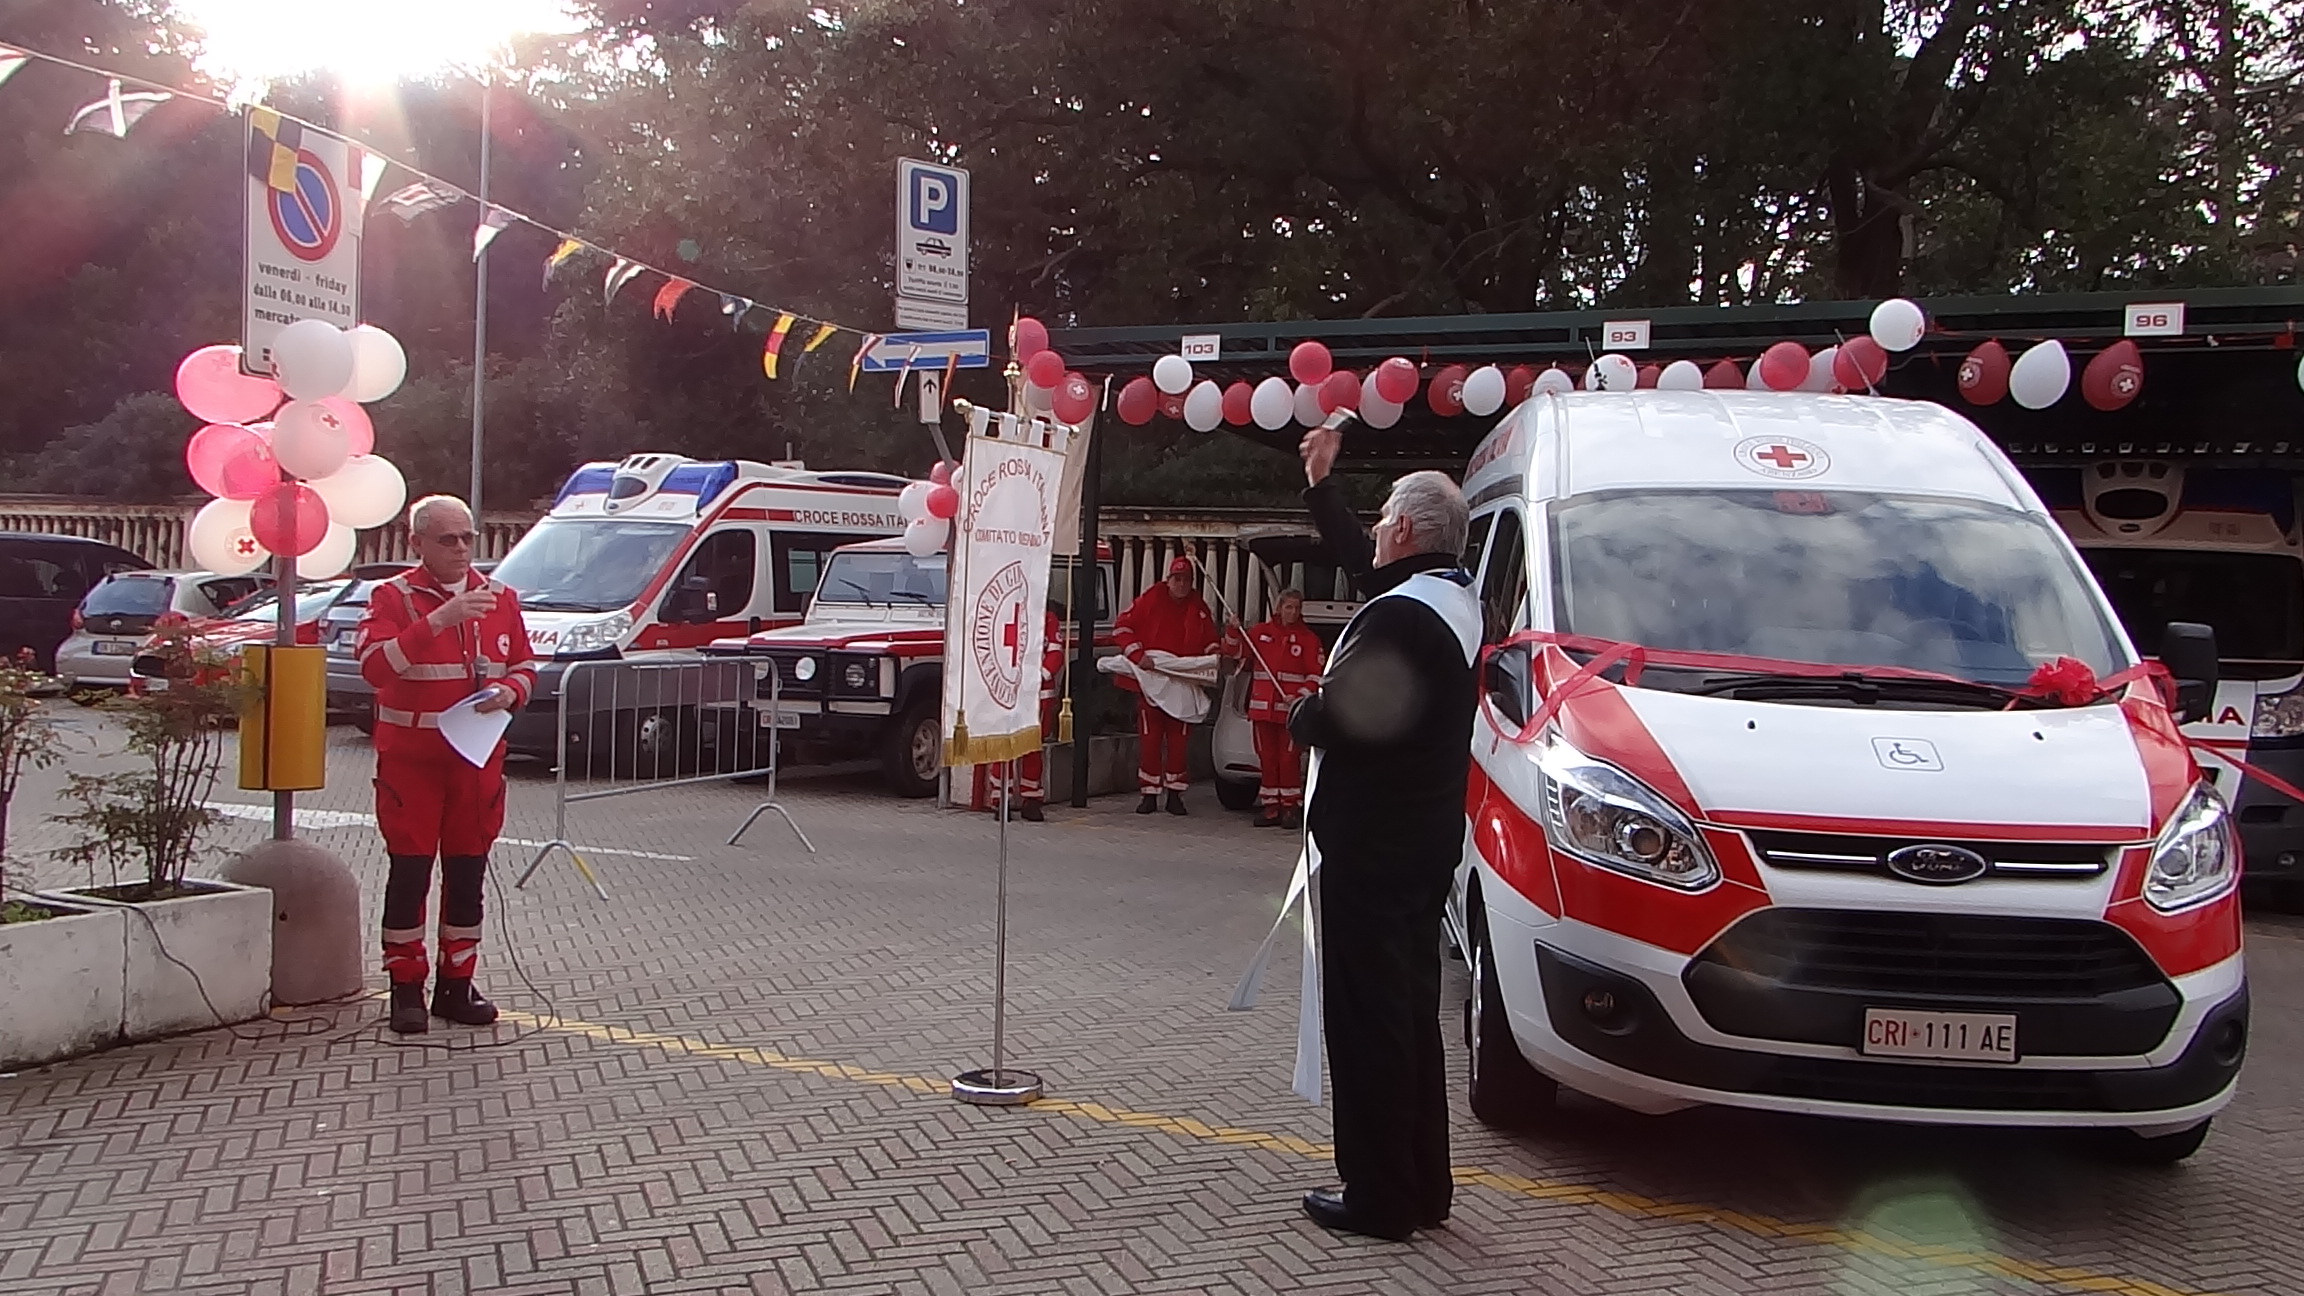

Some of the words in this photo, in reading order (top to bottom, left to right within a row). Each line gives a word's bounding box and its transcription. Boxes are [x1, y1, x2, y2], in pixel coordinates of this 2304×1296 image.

[315, 273, 347, 296] friday
[253, 282, 277, 299] dalle
[309, 296, 326, 311] alle
[2135, 315, 2168, 328] 96
[1611, 331, 1637, 343] 93
[1184, 344, 1214, 354] 103
[963, 470, 997, 534] CROCE
[794, 509, 839, 525] CROCE
[841, 511, 884, 527] ROSSA
[1868, 1019, 1907, 1046] CRI
[1926, 1022, 1967, 1049] 111
[1980, 1025, 2011, 1051] AE
